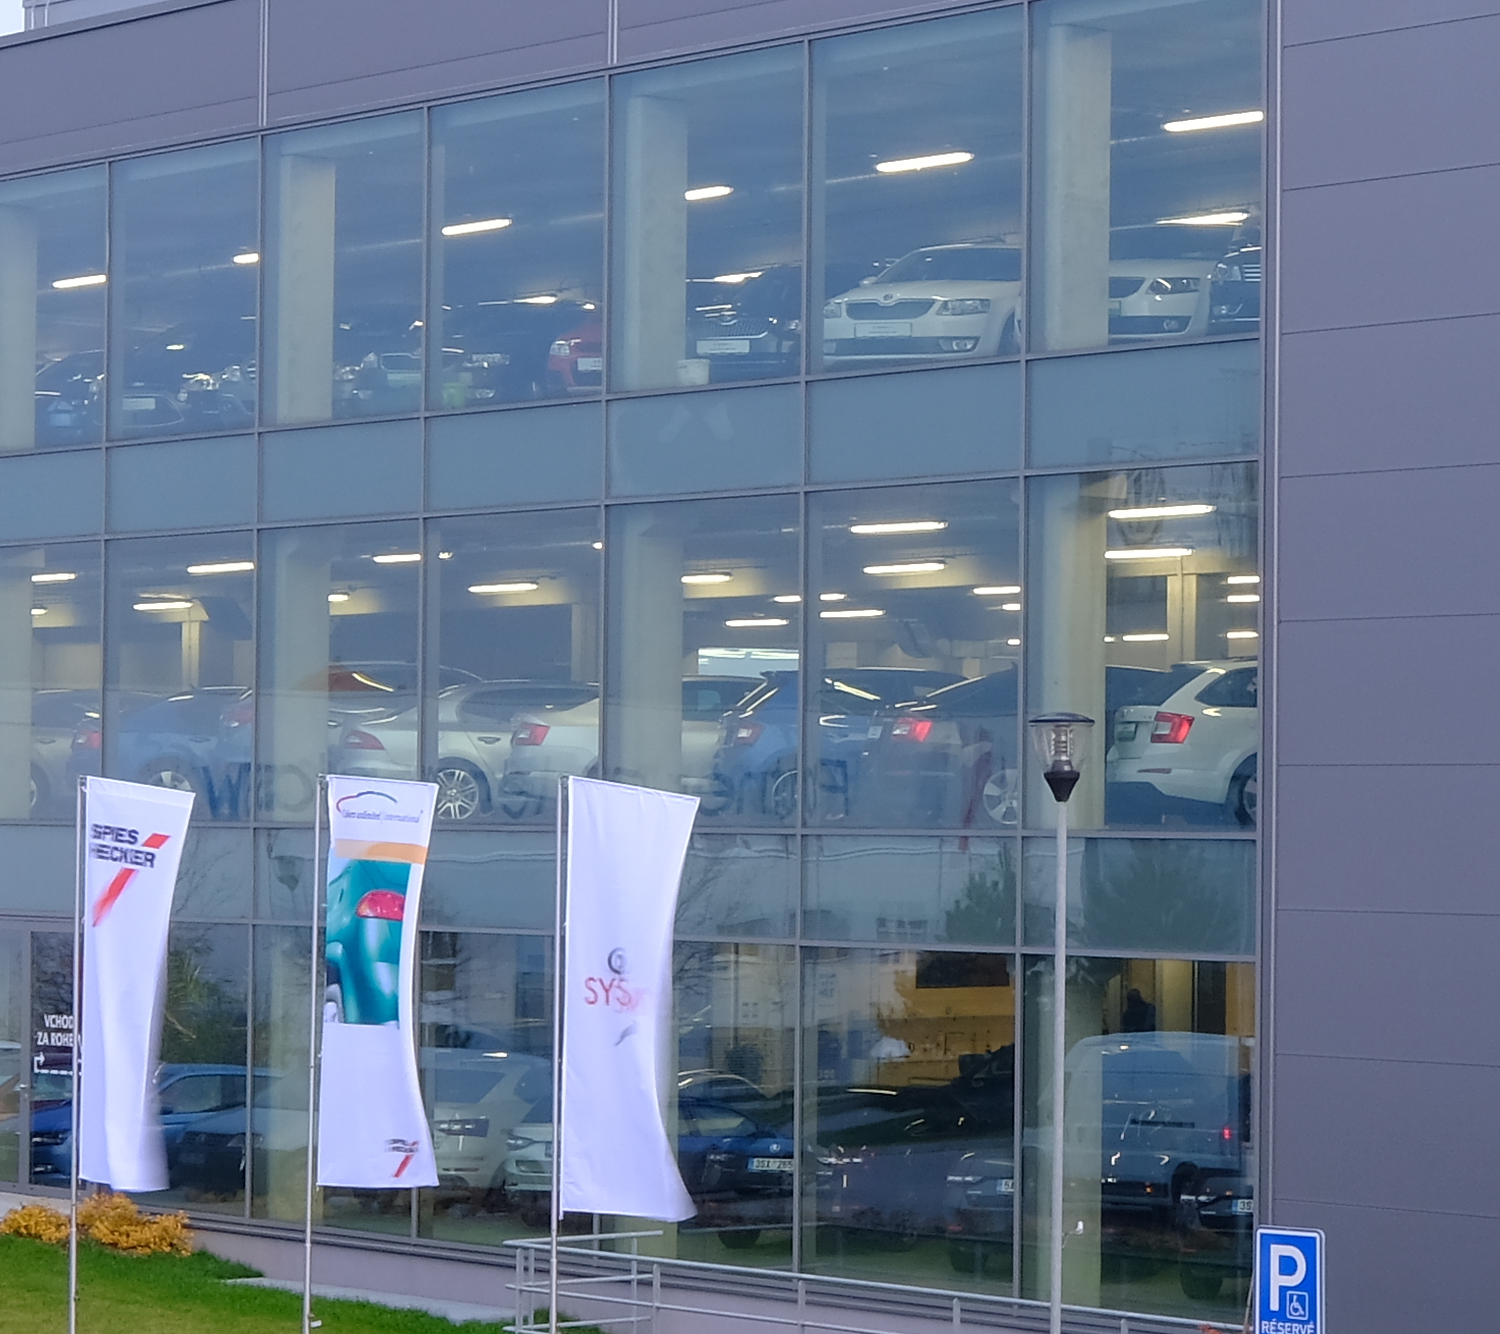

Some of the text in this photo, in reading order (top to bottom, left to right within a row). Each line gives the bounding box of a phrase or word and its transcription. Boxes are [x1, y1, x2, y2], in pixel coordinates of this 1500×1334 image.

[92, 823, 140, 845] SPIES
[37, 1031, 50, 1046] ZA
[1269, 1243, 1307, 1312] P
